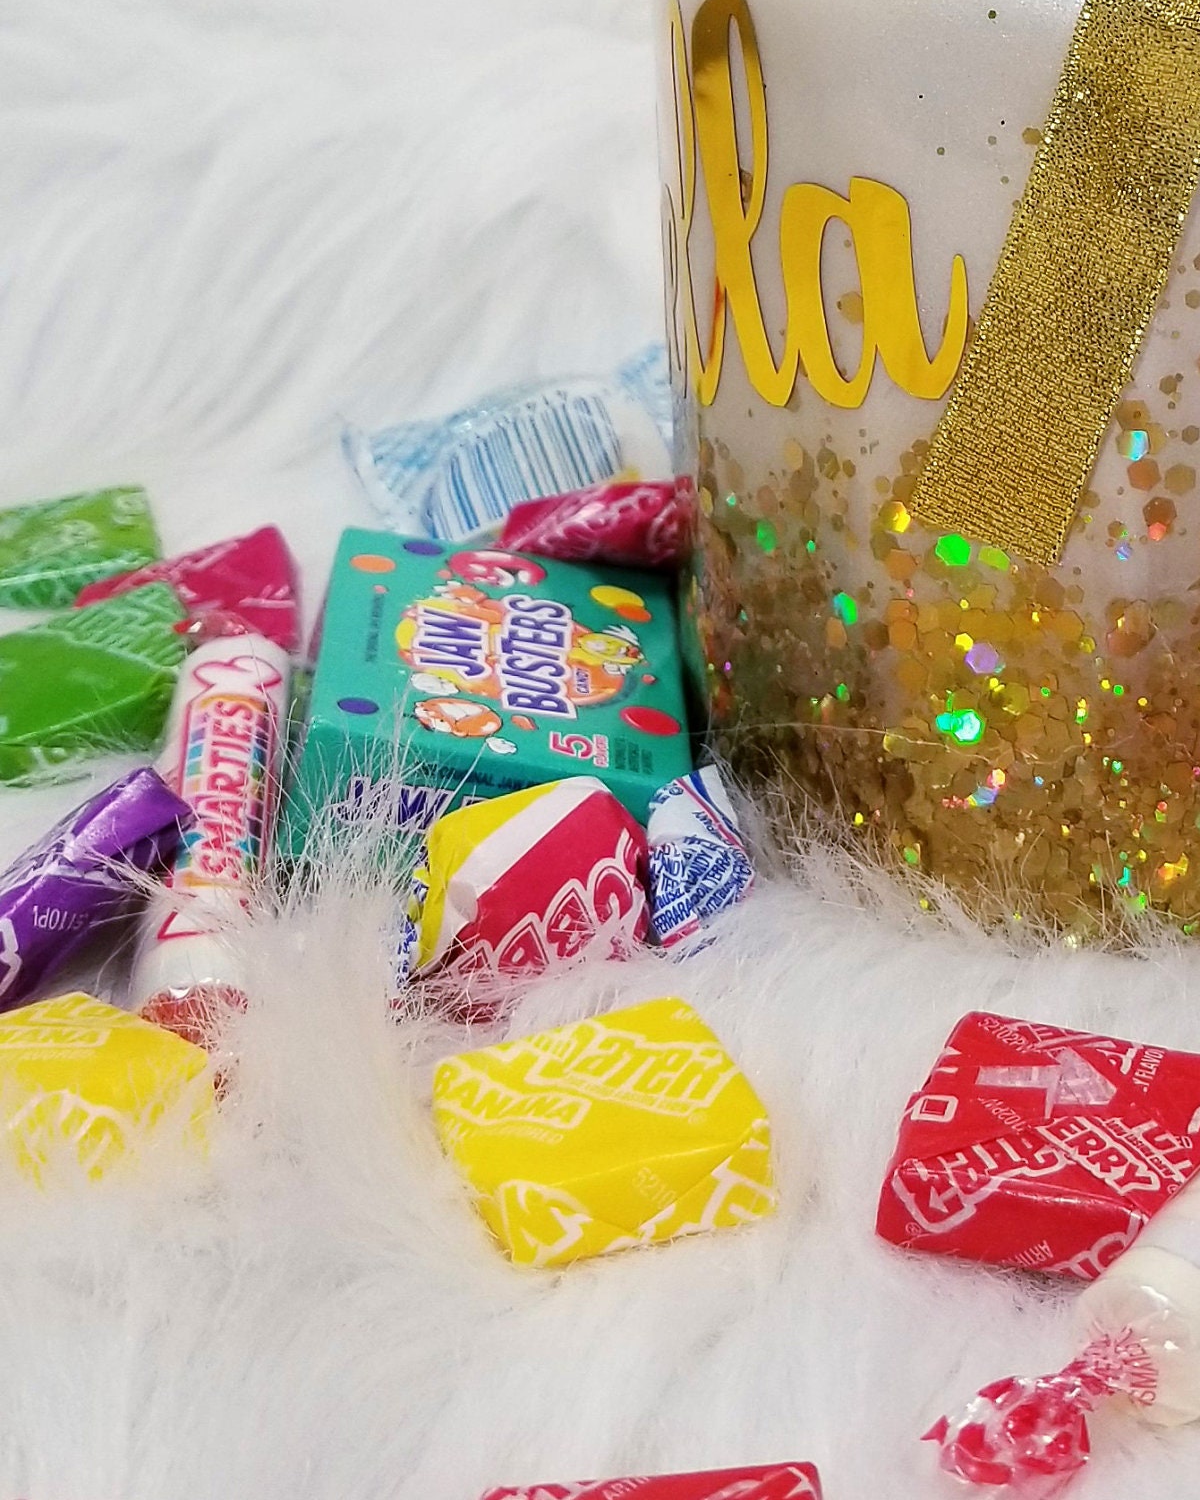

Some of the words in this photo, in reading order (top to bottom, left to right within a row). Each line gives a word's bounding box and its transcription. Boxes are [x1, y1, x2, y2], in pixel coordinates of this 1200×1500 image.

[417, 606, 490, 678] JAW
[500, 596, 573, 717] BUSTERS
[551, 731, 594, 760] 5
[200, 700, 254, 880] SMARTIES
[434, 1060, 580, 1122] BANANA
